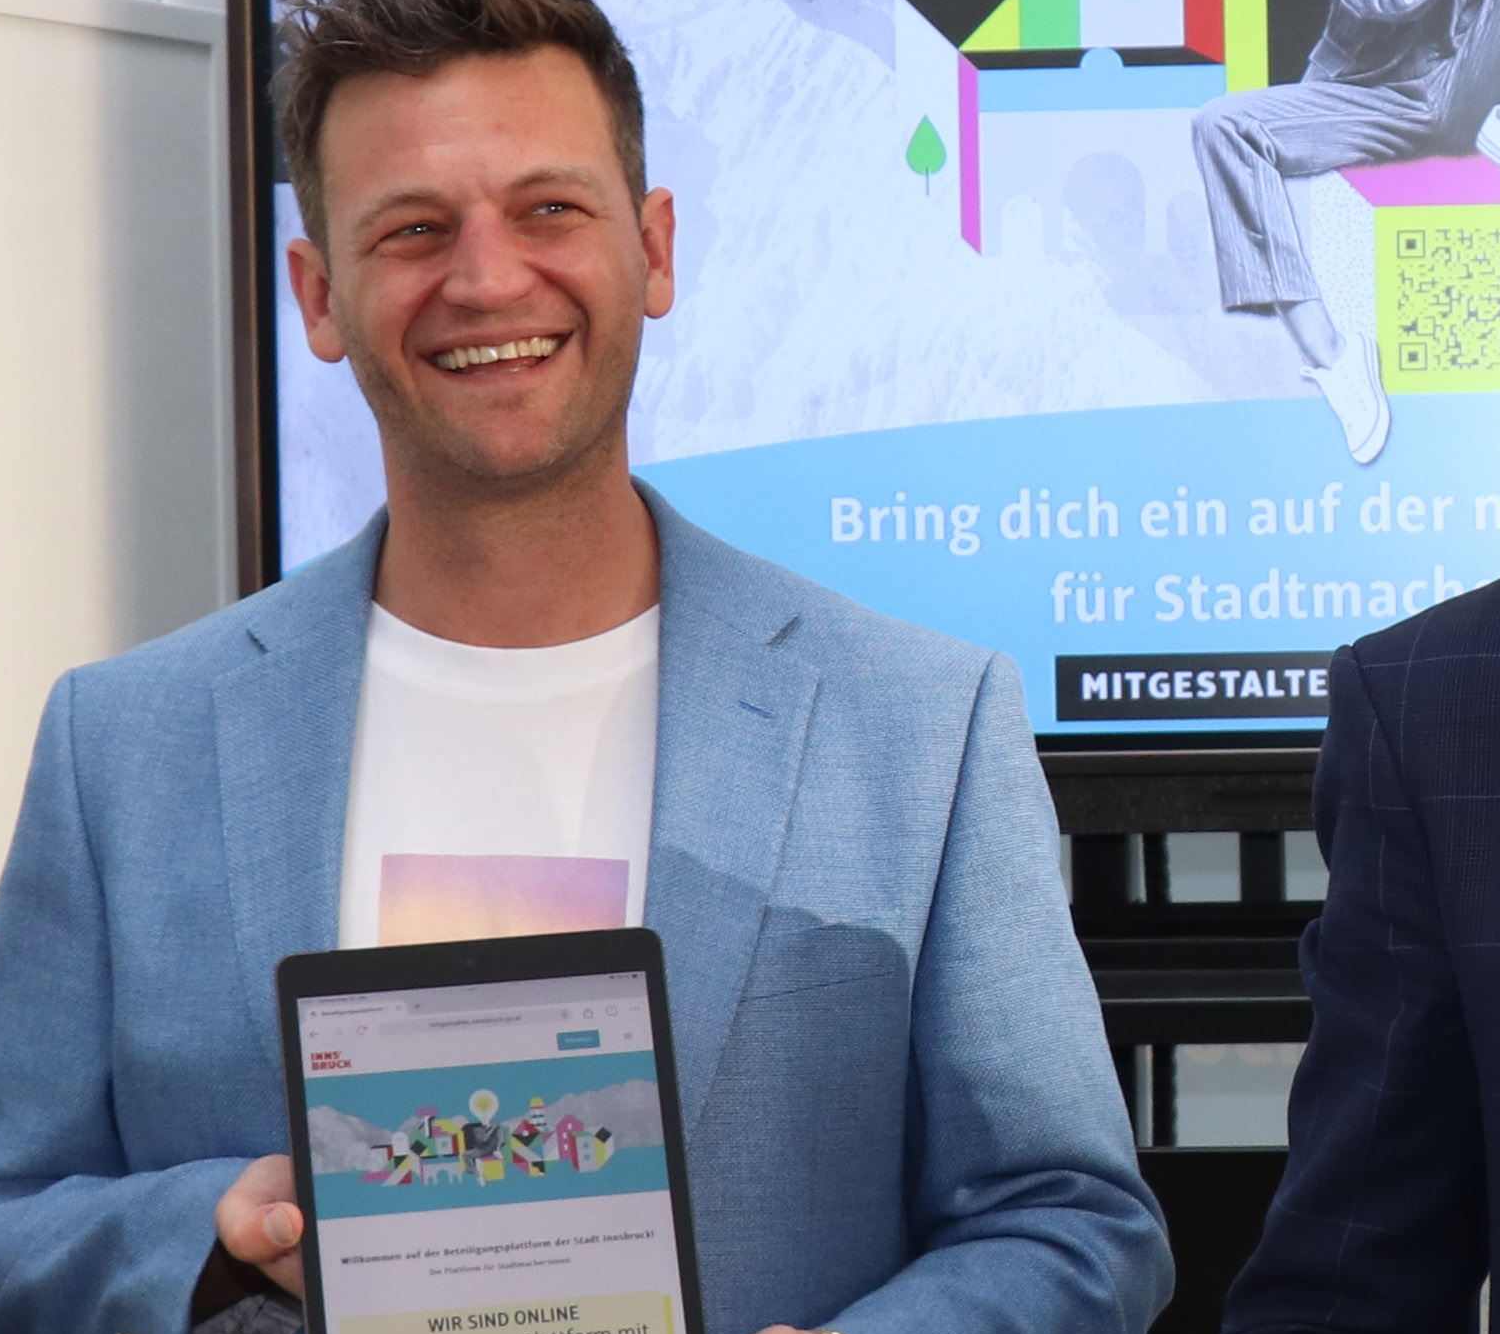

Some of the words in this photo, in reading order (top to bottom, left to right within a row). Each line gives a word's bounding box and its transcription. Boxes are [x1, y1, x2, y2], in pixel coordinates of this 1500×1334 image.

[830, 491, 982, 557] Bring
[999, 485, 1121, 542] dich
[1140, 492, 1227, 539] ein
[1246, 483, 1341, 537] auf
[1358, 480, 1455, 534] der
[1050, 571, 1135, 624] für
[311, 1059, 352, 1071] BRUCK
[573, 1234, 600, 1245] Stadt
[428, 1316, 463, 1333] WIR
[468, 1312, 509, 1330] SIND
[514, 1305, 579, 1326] ONLINE
